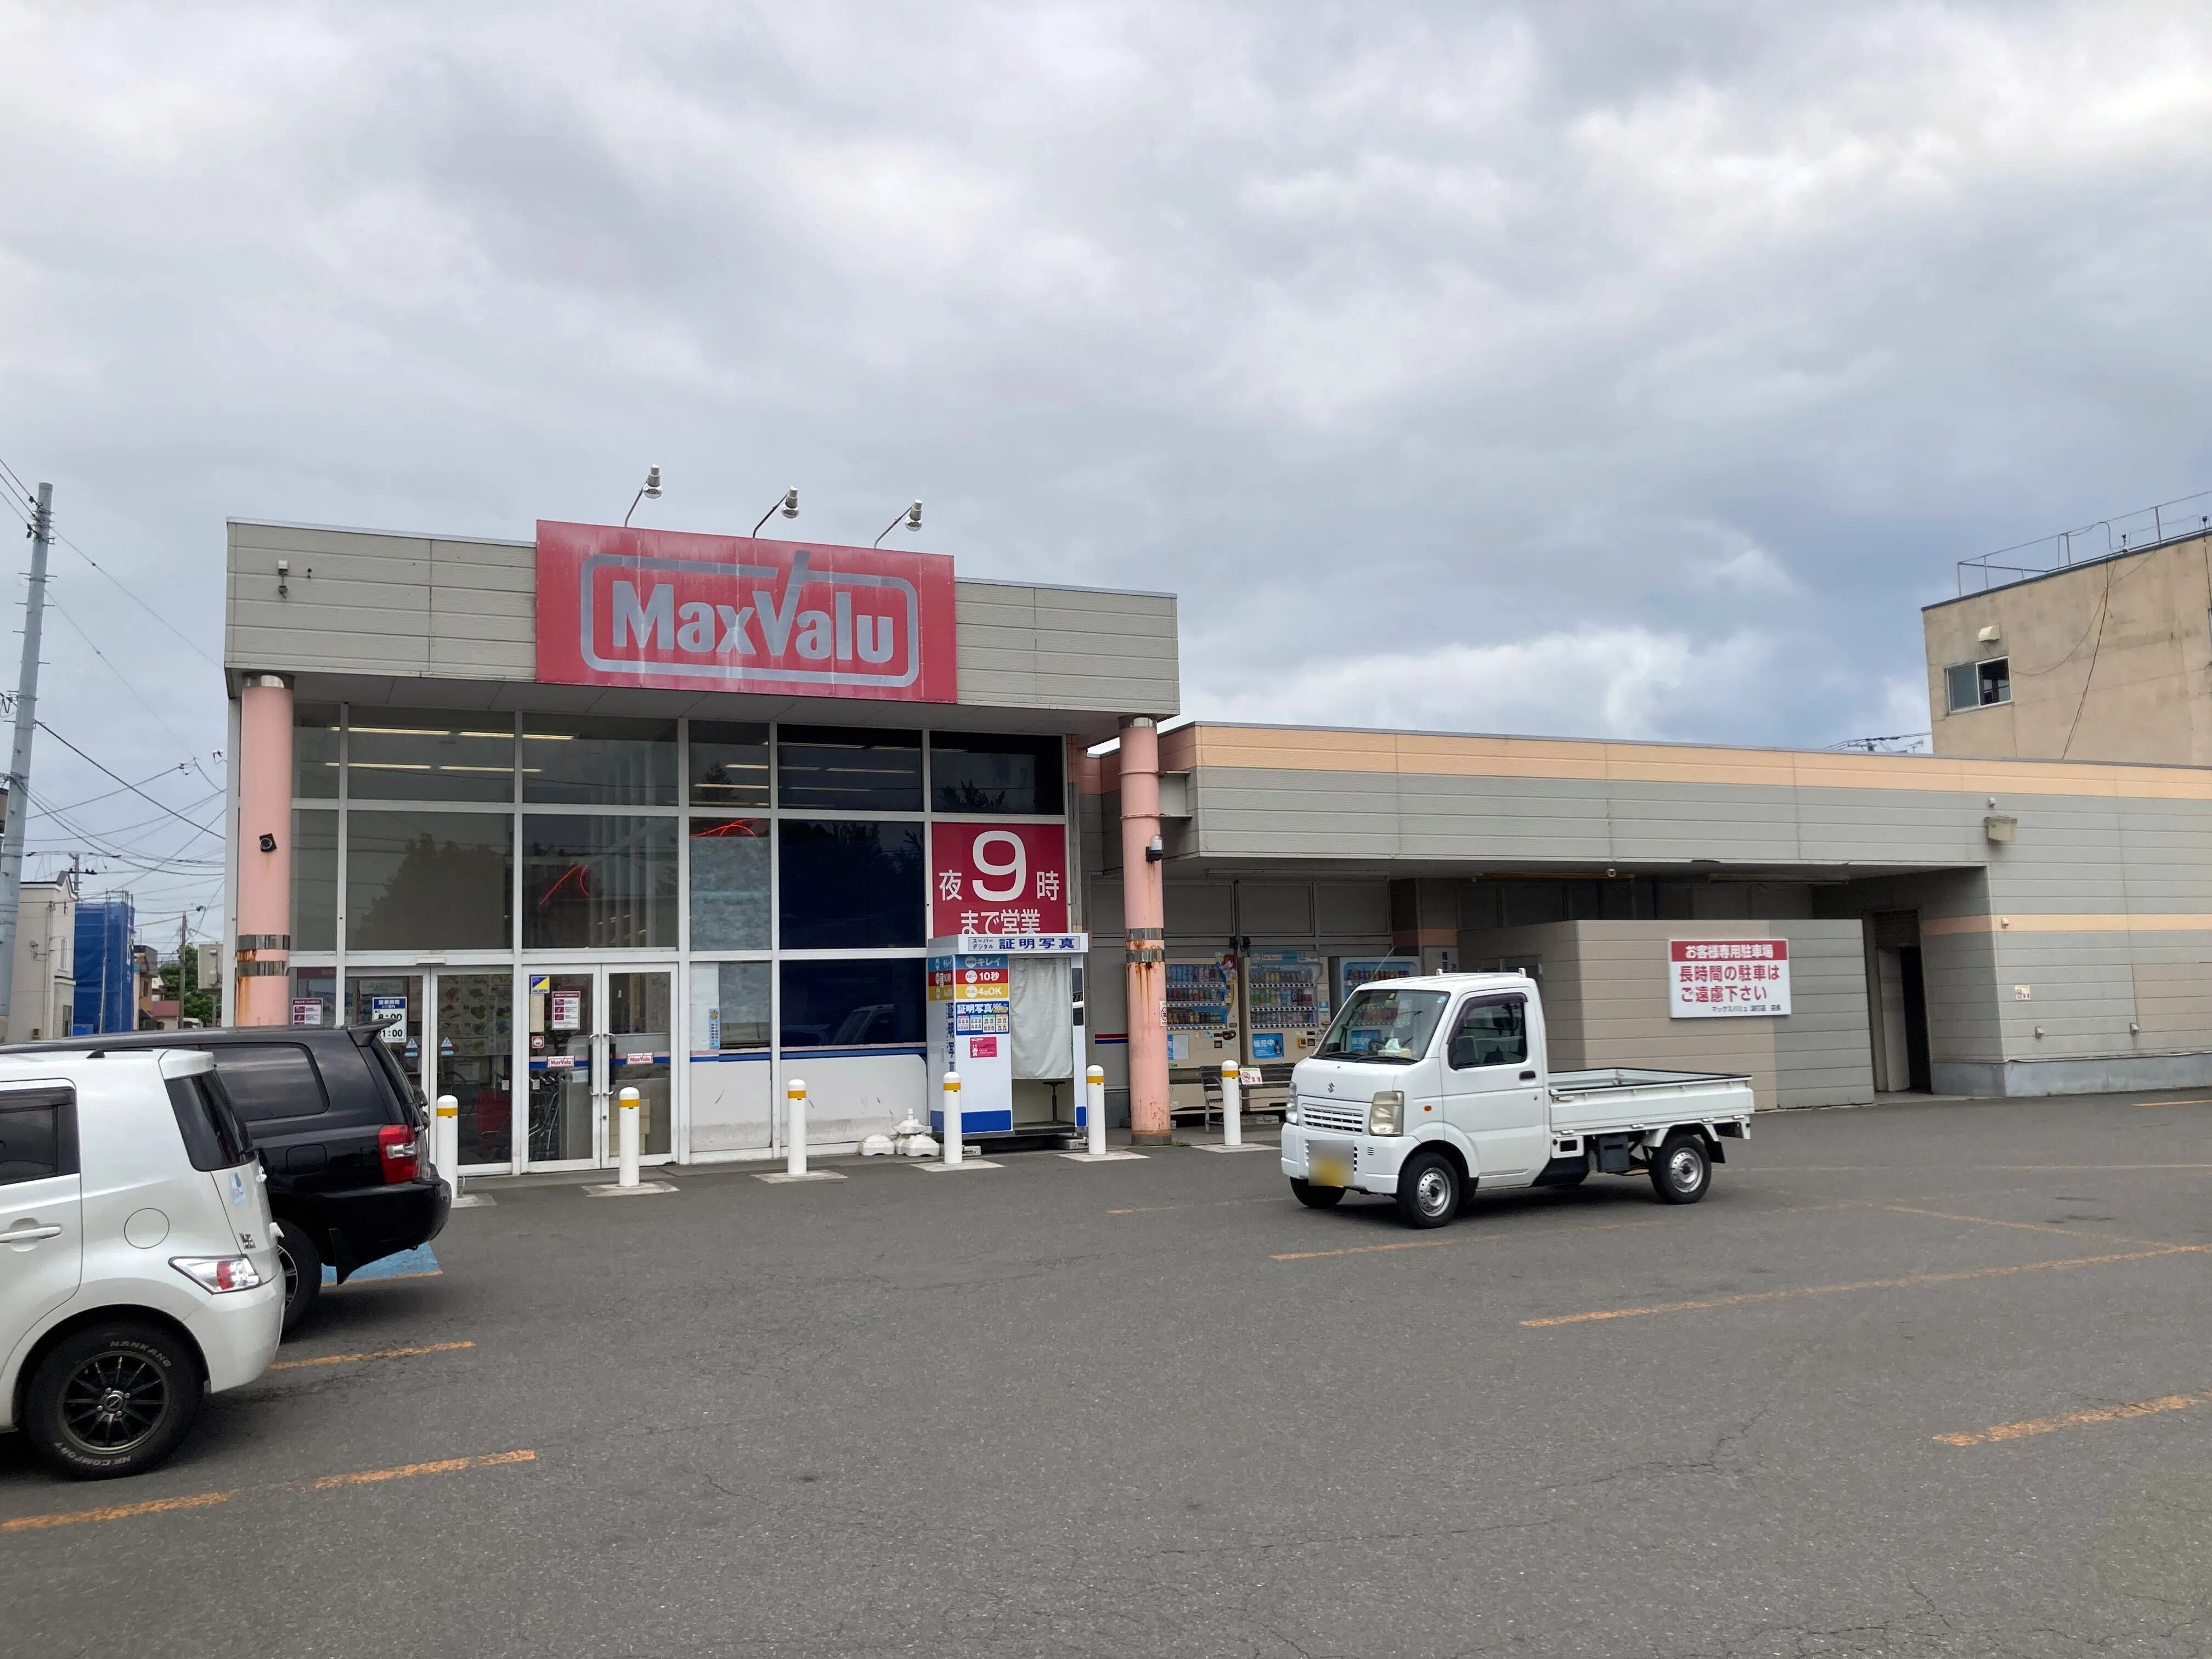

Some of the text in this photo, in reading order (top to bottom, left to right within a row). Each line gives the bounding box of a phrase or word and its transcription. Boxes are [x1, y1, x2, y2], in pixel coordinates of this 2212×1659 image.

[612, 550, 894, 664] MaxValu
[960, 909, 1041, 934] まで営業
[998, 938, 1075, 949] 証明写真
[1685, 944, 1774, 959] お客様専用駐車場
[977, 957, 1001, 967] キレイ
[979, 971, 1000, 981] 10秒
[1680, 964, 1780, 982] 長時間の駐車は
[1681, 985, 1768, 1002] ご遠慮下さい
[957, 1003, 992, 1014] 証明写真
[550, 1057, 572, 1065] MaxValu
[630, 1054, 651, 1062] MaxValu
[110, 1340, 172, 1367] NANKANG
